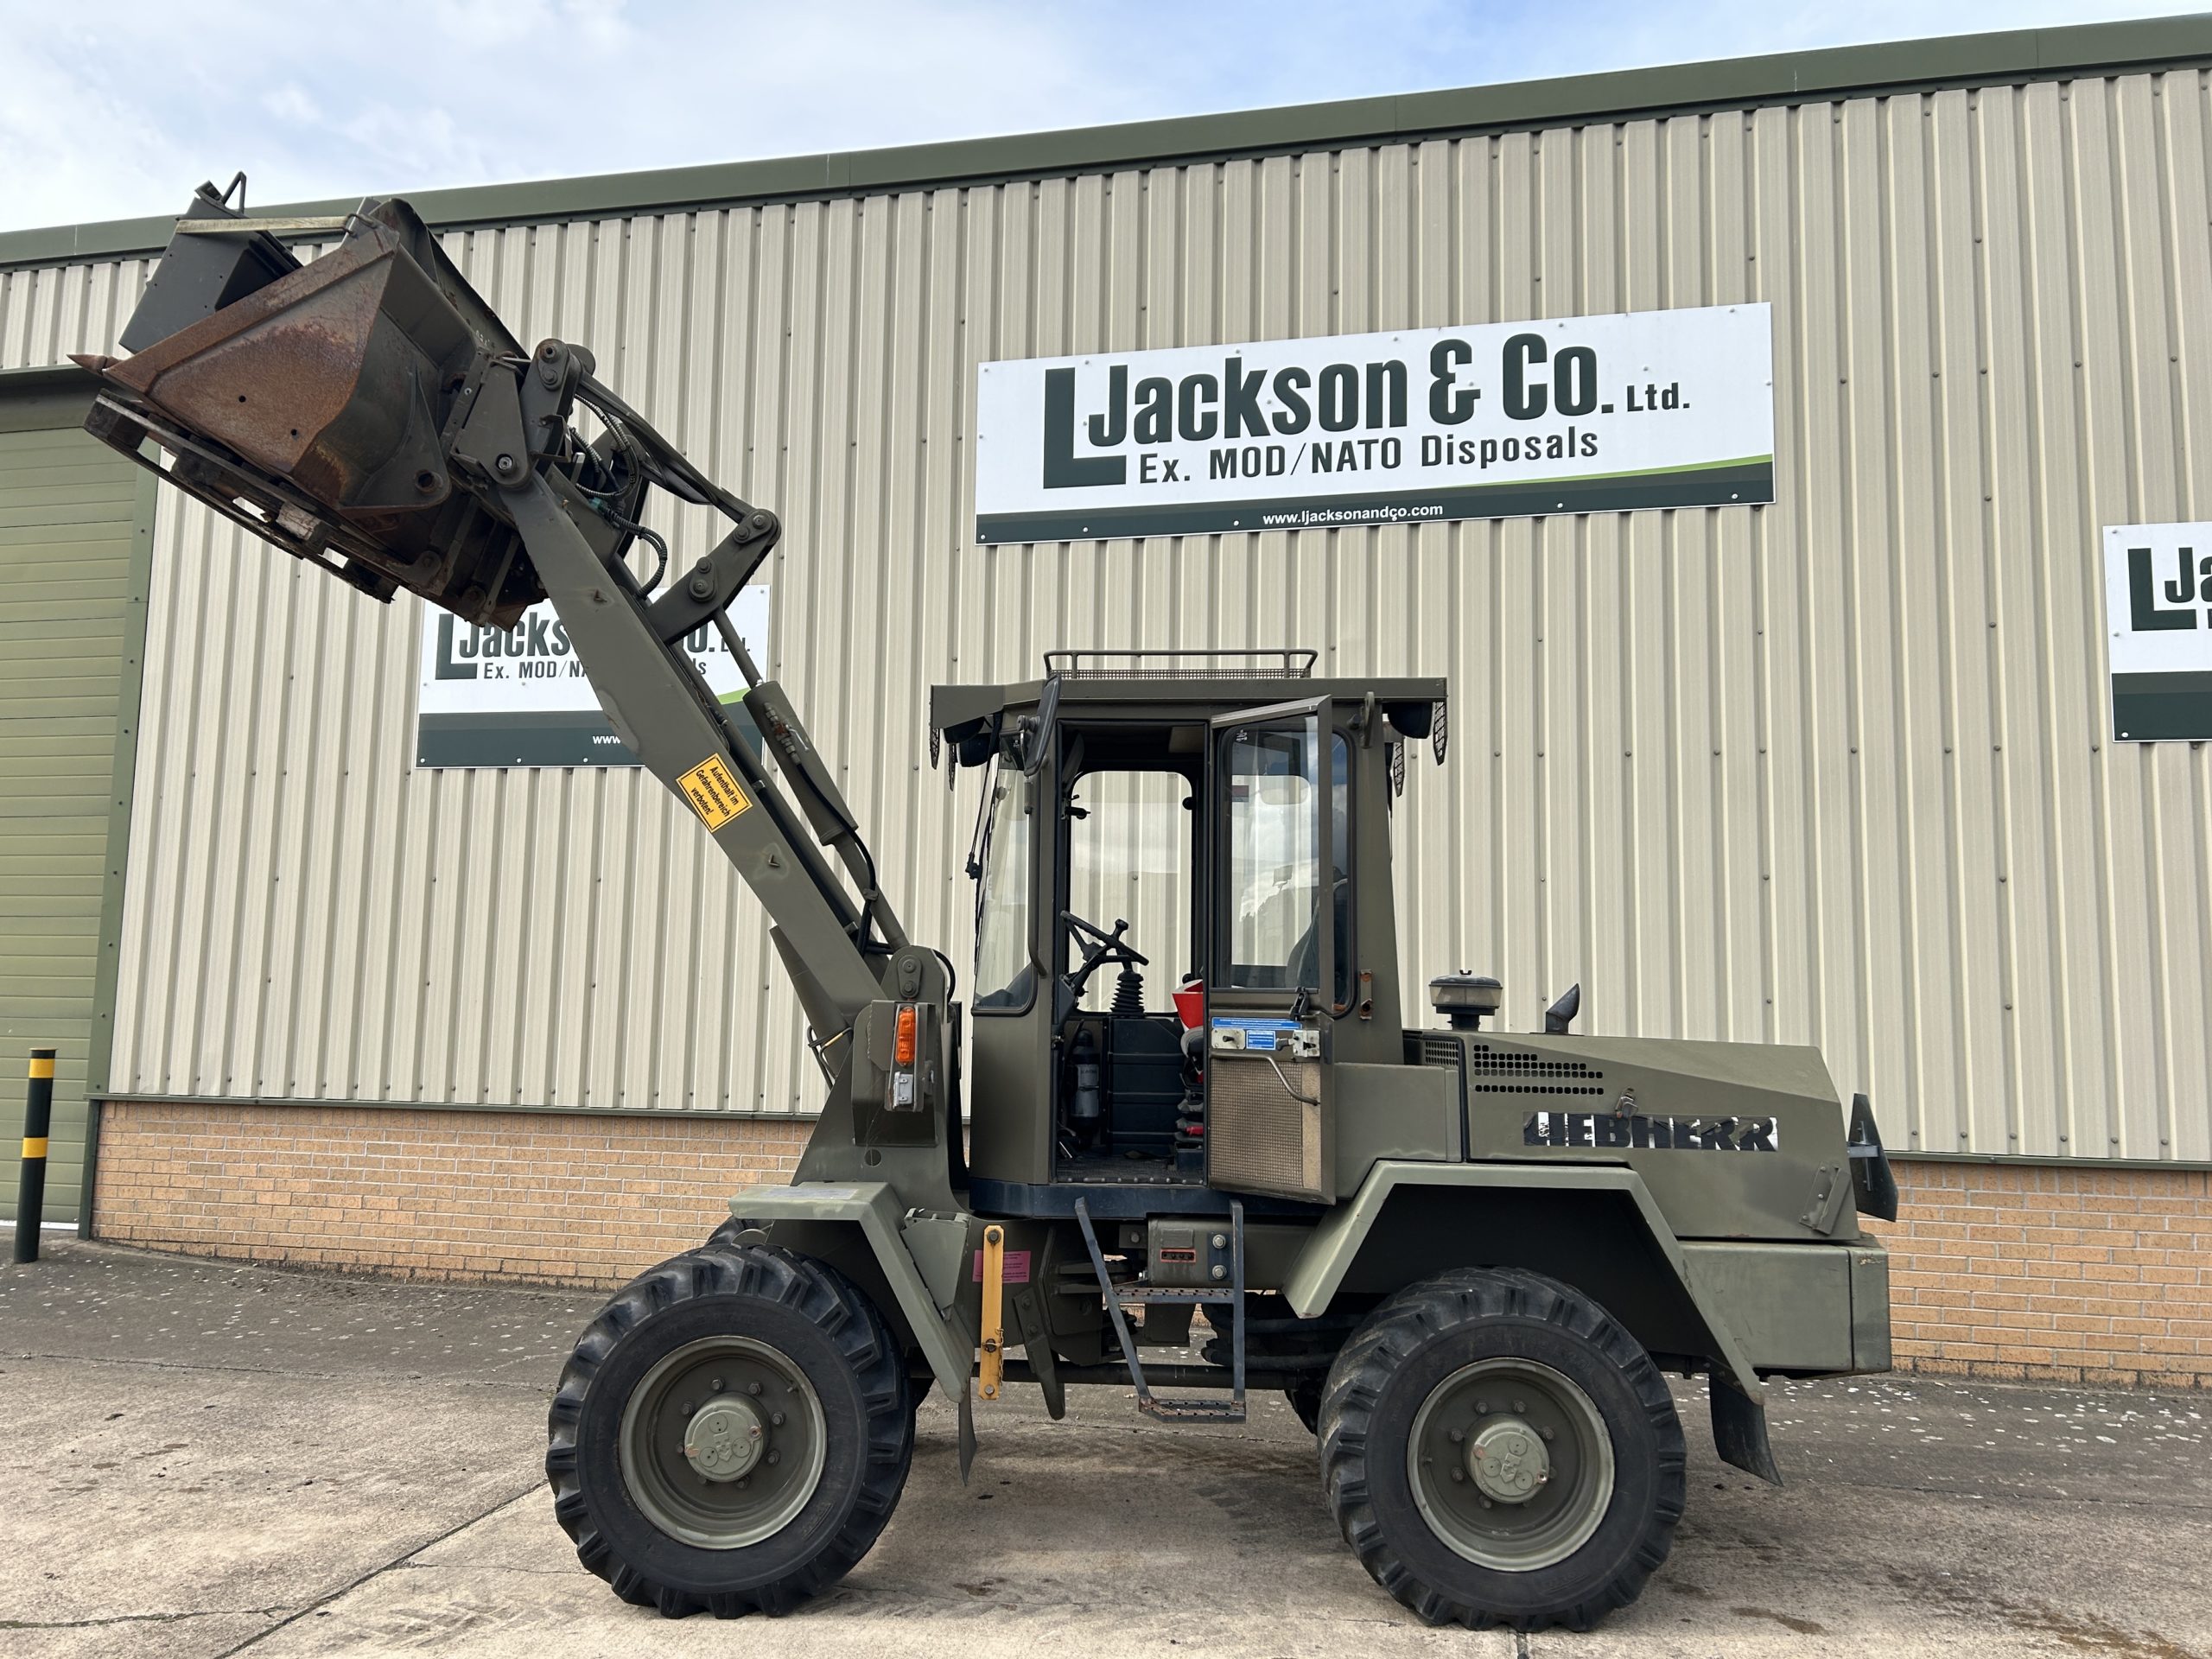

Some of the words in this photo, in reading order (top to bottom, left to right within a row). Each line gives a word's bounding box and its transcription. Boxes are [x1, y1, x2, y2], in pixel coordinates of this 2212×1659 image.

[1429, 339, 1481, 425] &
[1503, 333, 1614, 421] Co.
[1627, 382, 1691, 412] Ltd.
[1140, 453, 1191, 484] Ex.
[1210, 437, 1402, 480] MOD/NATO
[1421, 426, 1599, 469] Disposals
[484, 662, 510, 679] Ex.
[690, 787, 714, 816] verboten!
[696, 770, 731, 817] Gefahrenbereich
[709, 766, 735, 798] Aufenthalt
[729, 794, 740, 805] im
